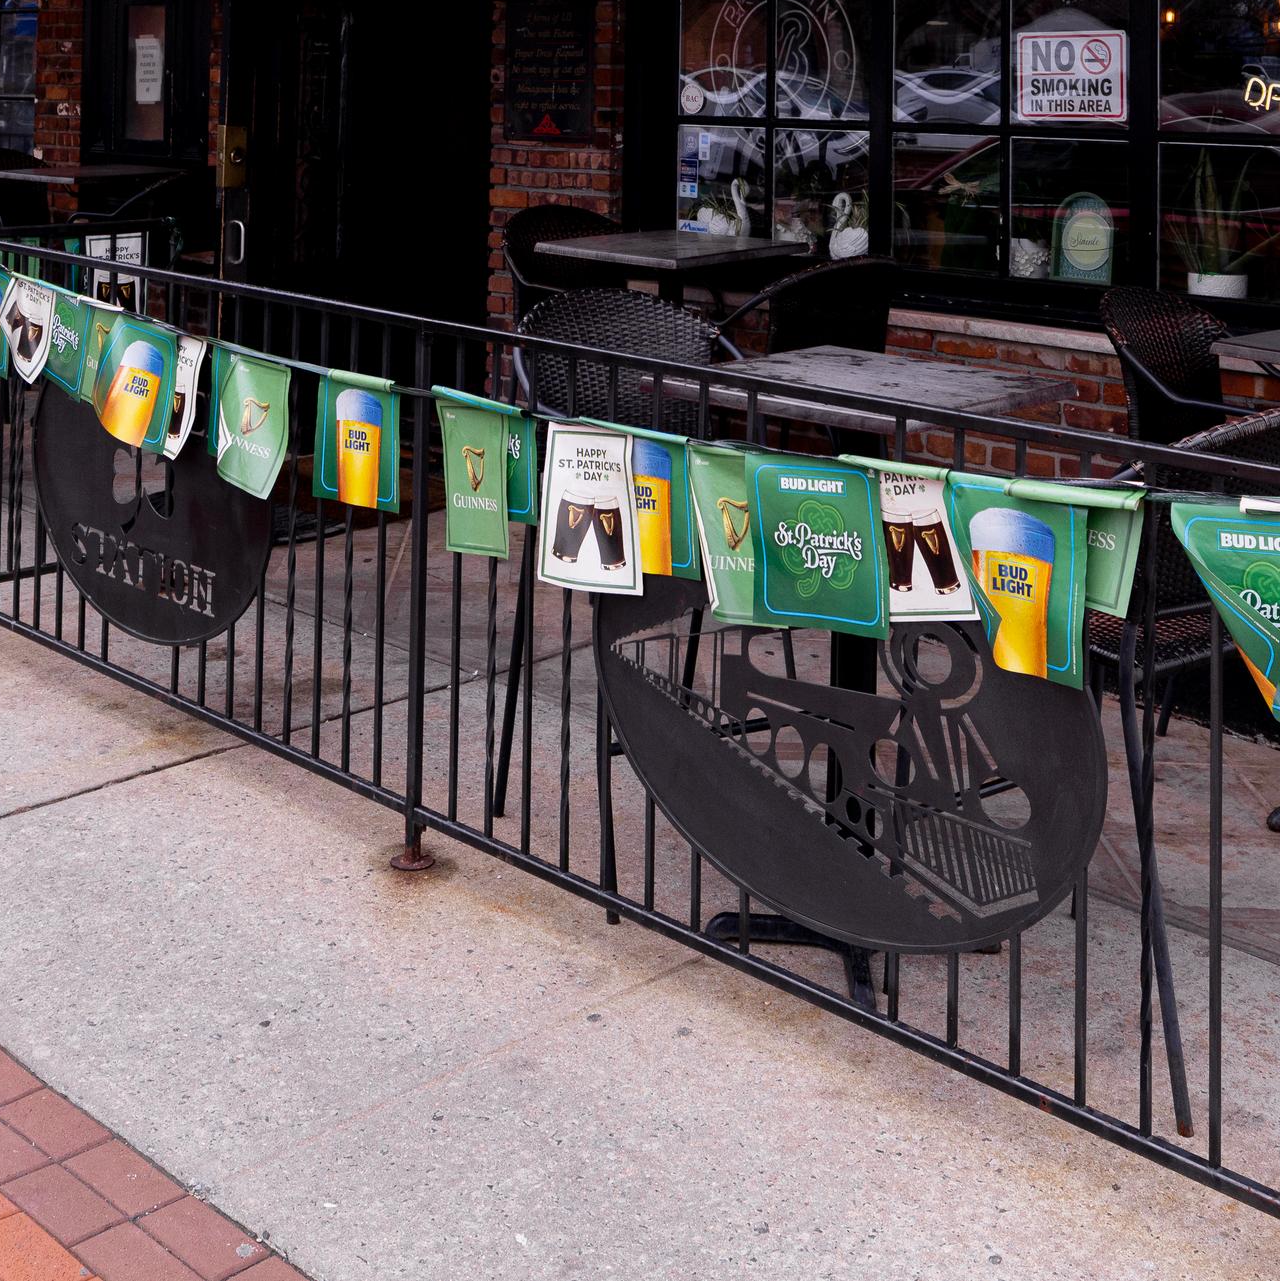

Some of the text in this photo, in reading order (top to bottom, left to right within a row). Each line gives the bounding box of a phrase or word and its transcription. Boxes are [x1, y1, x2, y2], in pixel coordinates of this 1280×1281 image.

[1031, 40, 1076, 72] NO
[1030, 78, 1112, 97] SMOKING
[1031, 100, 1112, 112] IN THIS AREA
[26, 284, 50, 303] PATRICK'S
[30, 295, 39, 305] DAY
[131, 375, 149, 387] BUD
[124, 384, 150, 399] LIGHT
[349, 430, 367, 440] BUD
[345, 439, 371, 452] LIGHT
[576, 448, 608, 459] HAPPY
[558, 459, 621, 473] ST. PATRICK'S
[583, 471, 603, 482] DAY
[780, 477, 845, 493] BUD LIGHT
[894, 484, 917, 497] DAY
[453, 493, 498, 513] GUINNESS
[636, 497, 657, 511] GHT
[1220, 532, 1257, 551] BUD
[71, 522, 216, 618] STATION
[802, 549, 838, 579] Day
[998, 564, 1028, 581] BUD
[992, 577, 1033, 598] LIGHT
